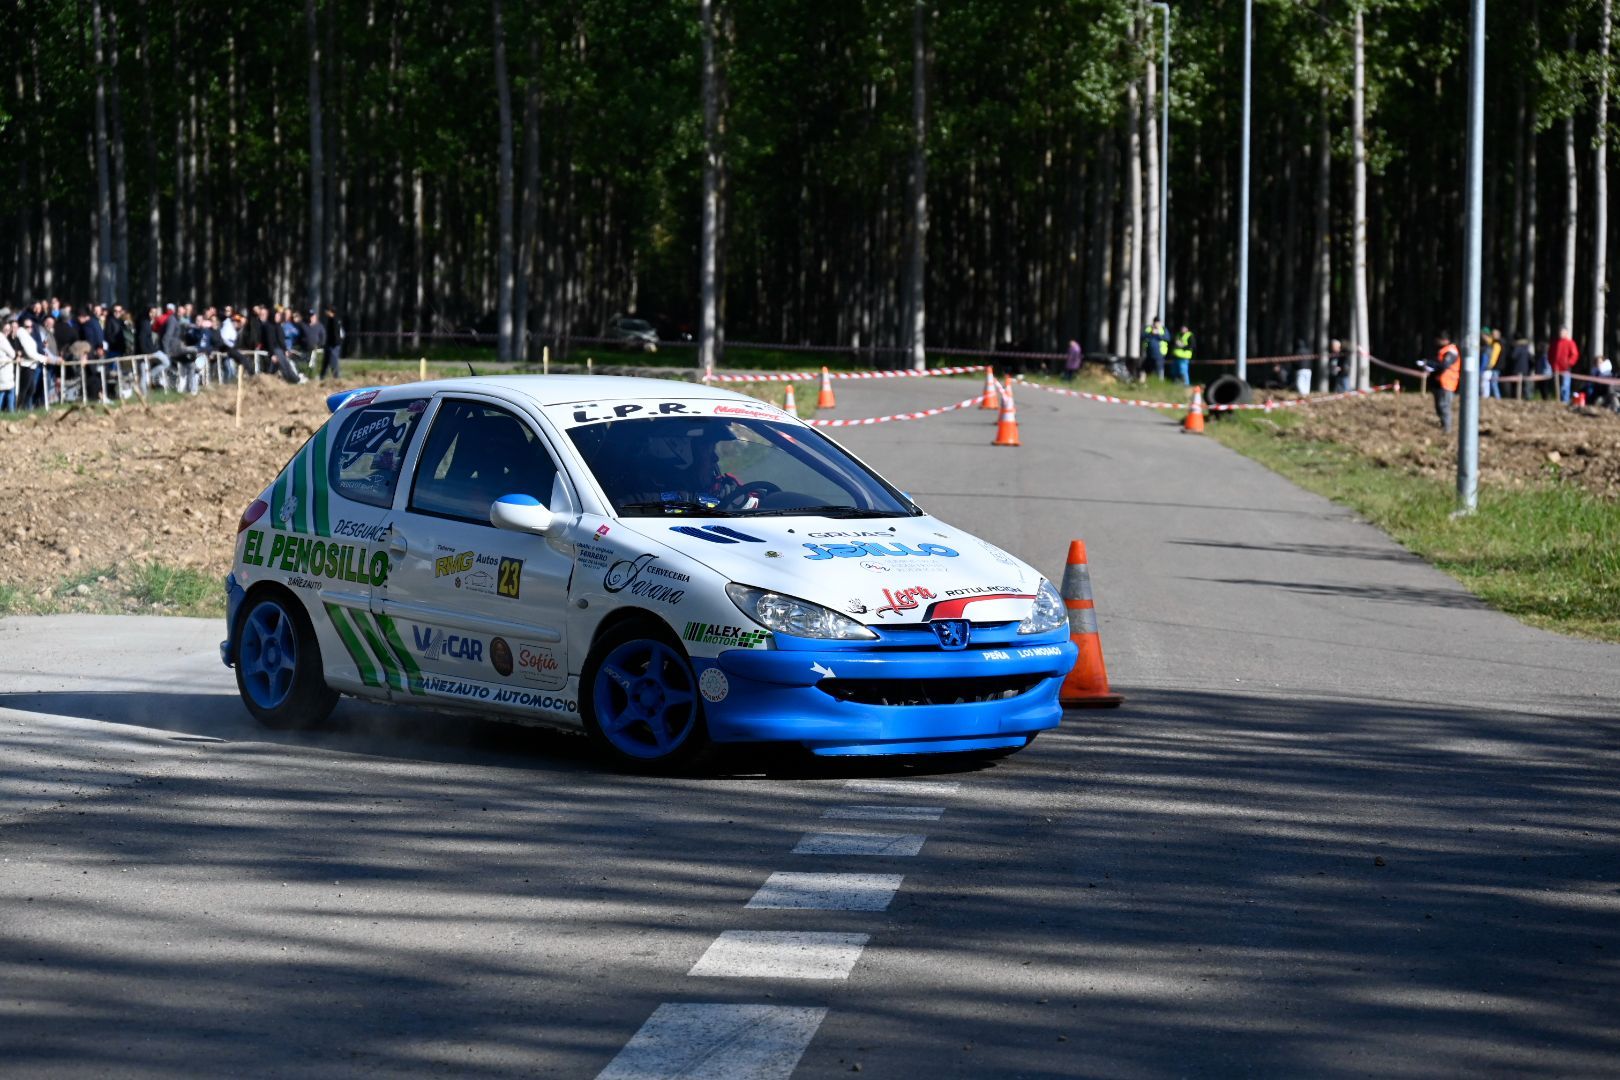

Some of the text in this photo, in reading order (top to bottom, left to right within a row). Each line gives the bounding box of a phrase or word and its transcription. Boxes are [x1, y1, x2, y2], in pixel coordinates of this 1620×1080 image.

[334, 519, 388, 542] DESGUACE
[808, 531, 895, 539] GRUAS
[242, 530, 389, 587] EL PENOSILLO
[435, 551, 499, 578] RMG Autos
[498, 560, 520, 596] 23
[647, 565, 690, 582] CERVECERIA
[702, 634, 738, 646] MOTOR
[706, 624, 741, 638] ALEX
[982, 650, 1010, 661] PEÑA
[493, 688, 580, 714] AUTOMOCIO
